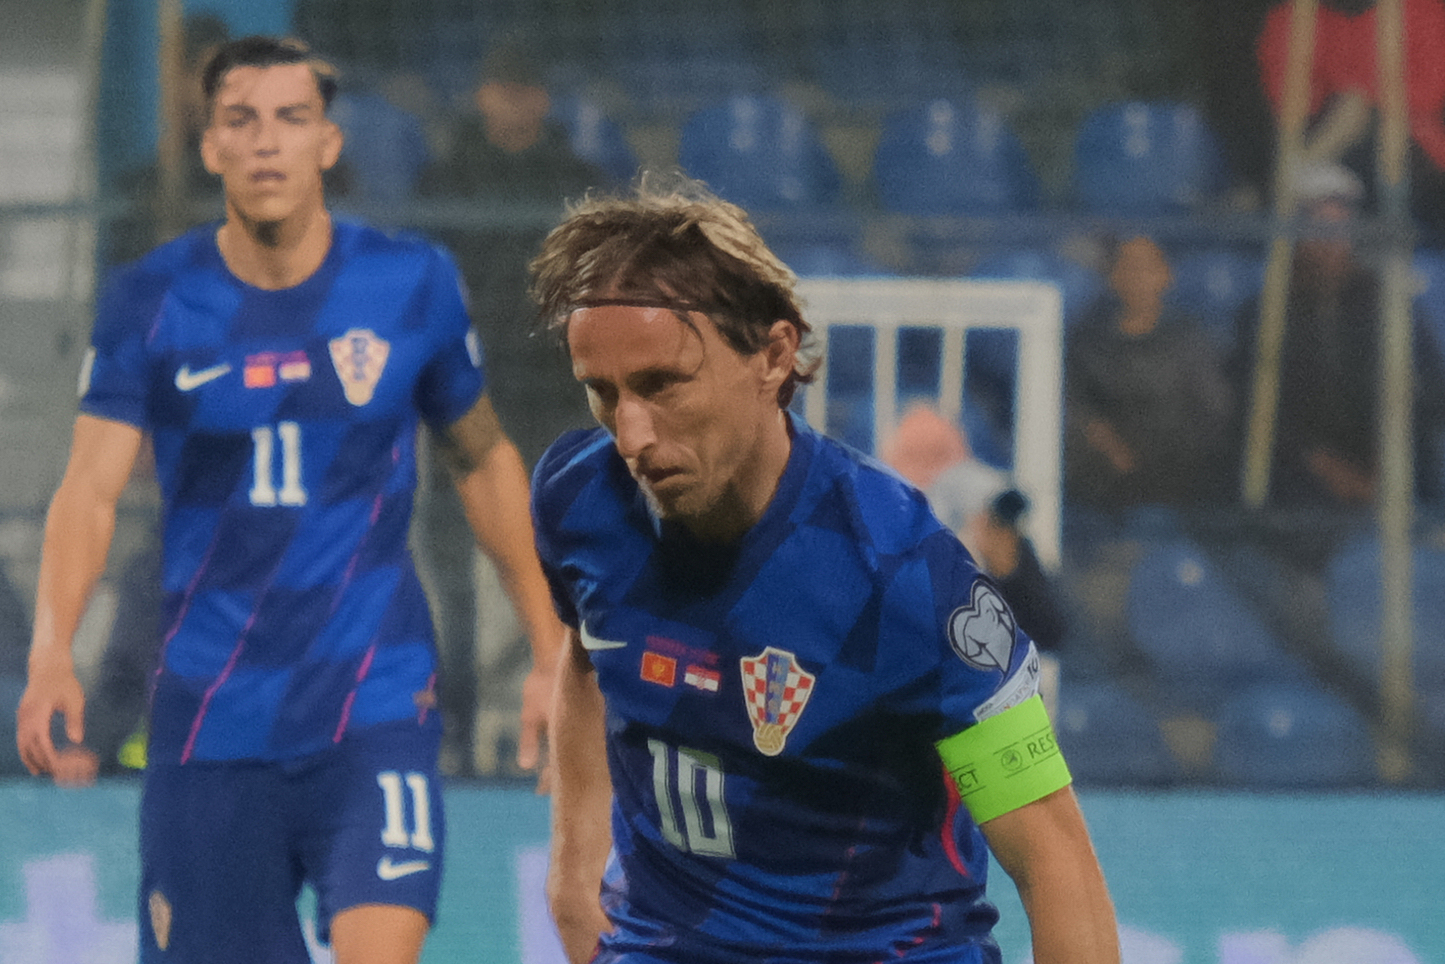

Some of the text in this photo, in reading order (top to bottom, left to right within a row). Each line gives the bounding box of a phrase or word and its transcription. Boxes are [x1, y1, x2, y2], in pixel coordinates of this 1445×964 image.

[249, 421, 309, 507] 11
[377, 771, 434, 853] 11
[647, 737, 737, 859] 10
